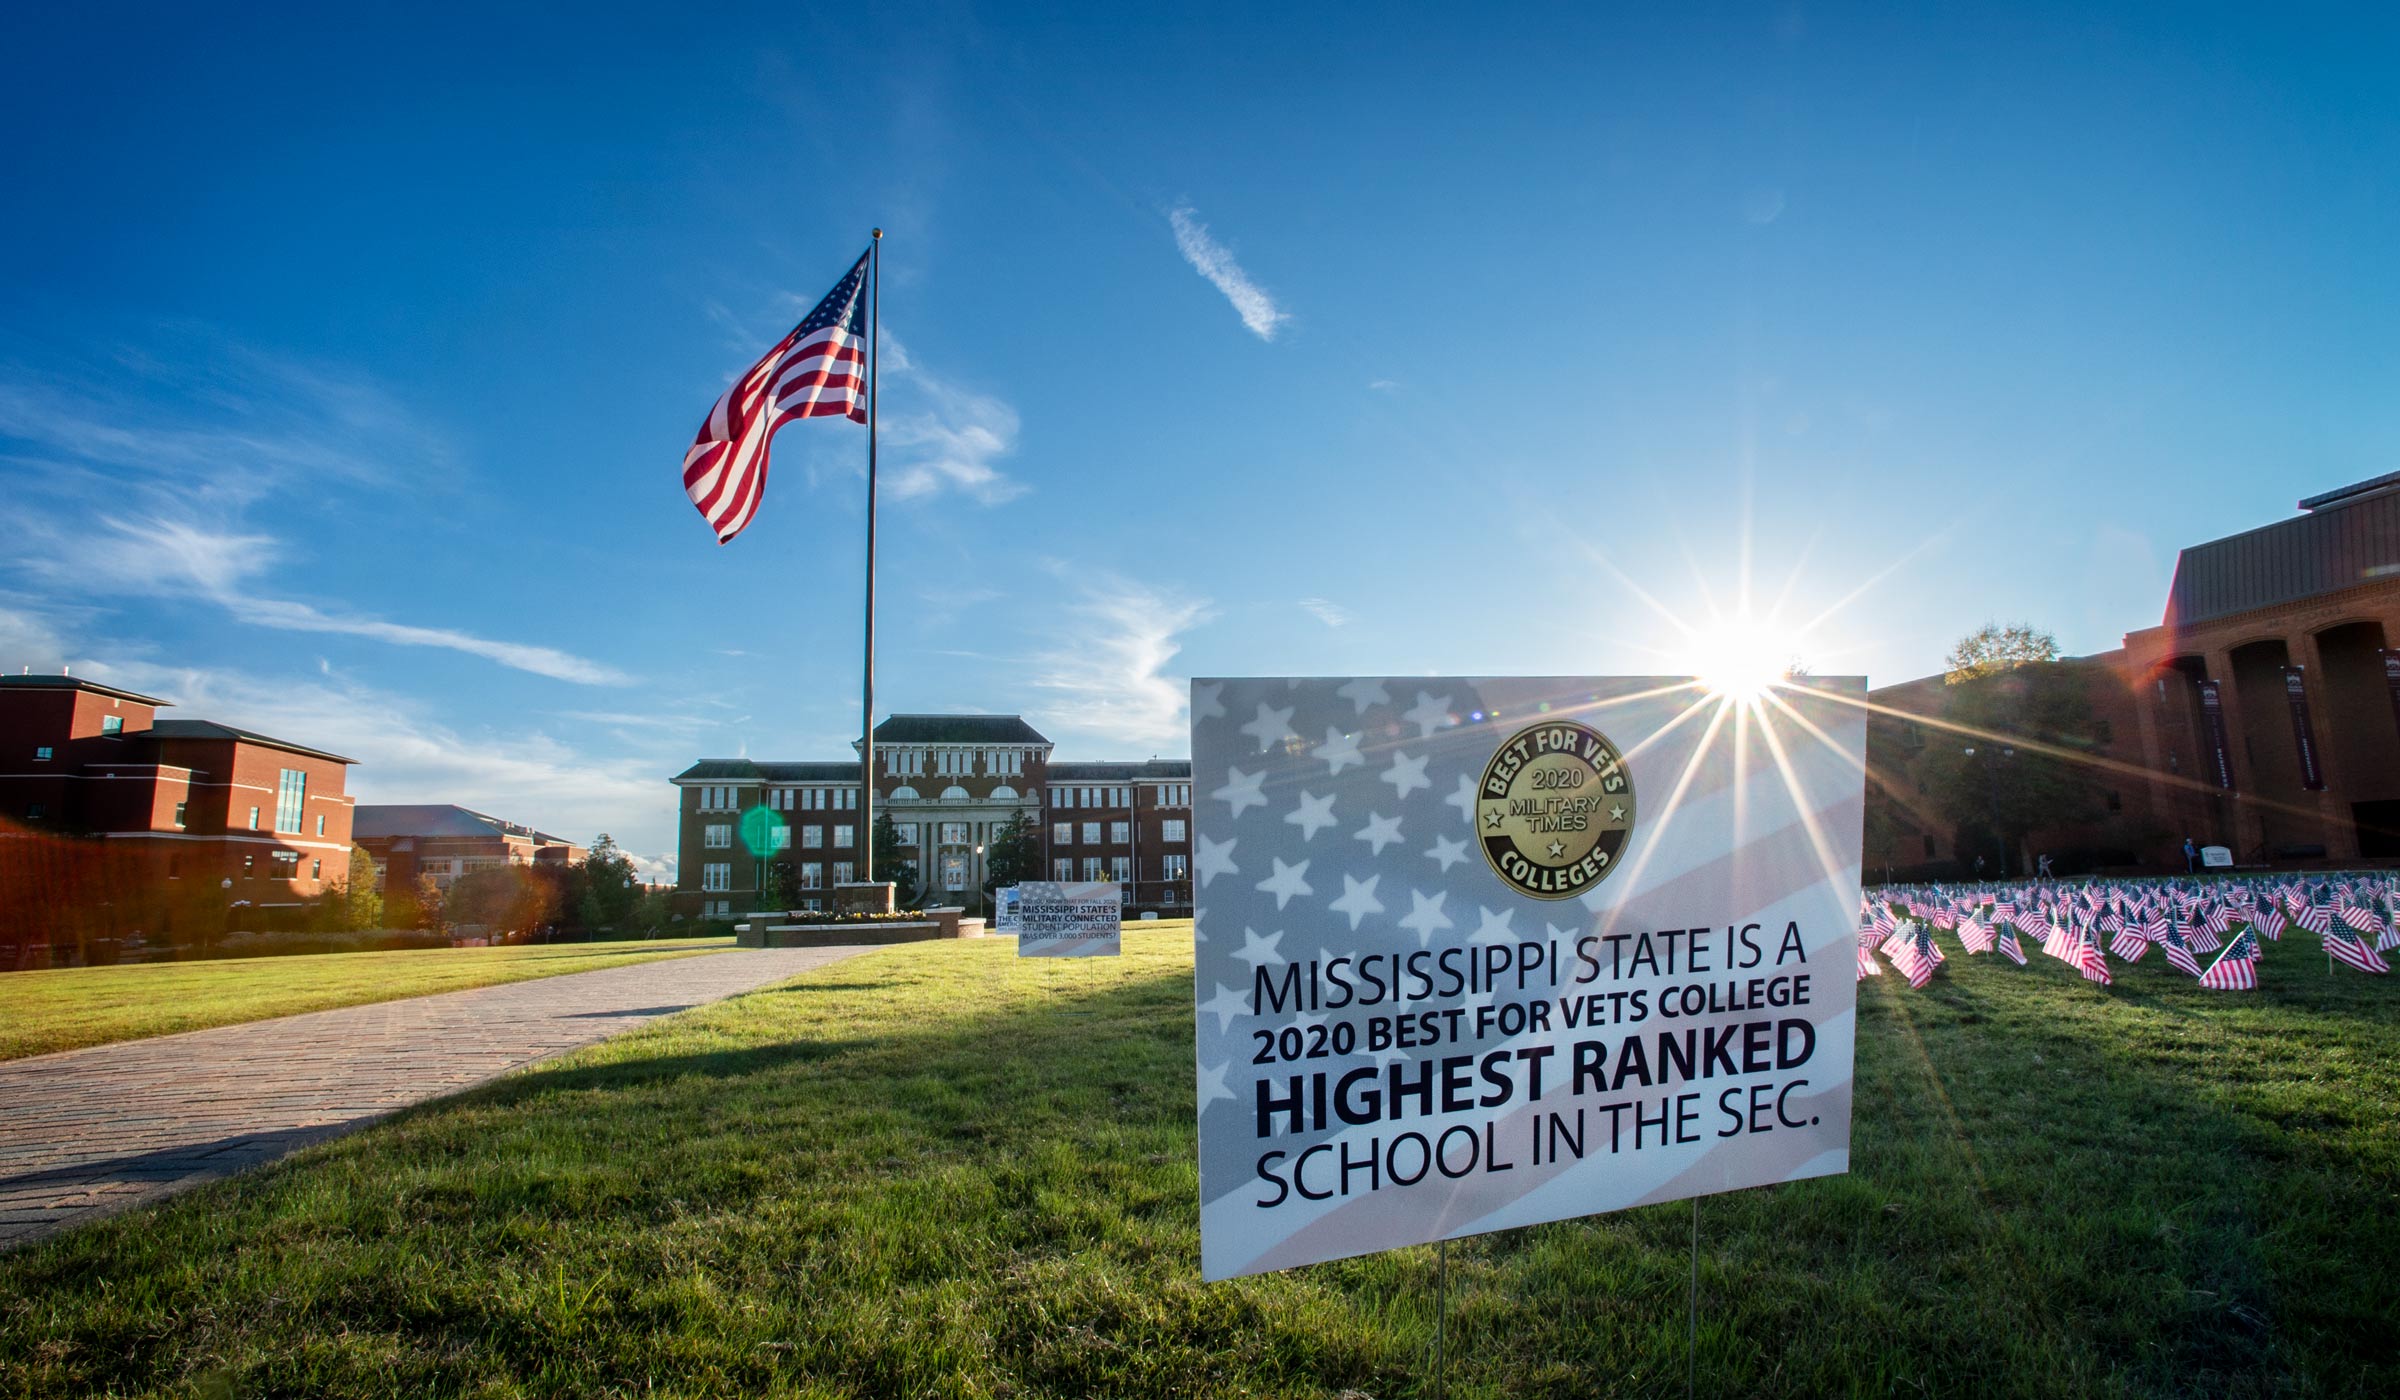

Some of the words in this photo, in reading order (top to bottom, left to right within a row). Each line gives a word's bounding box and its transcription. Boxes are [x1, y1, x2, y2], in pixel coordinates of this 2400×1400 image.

[1487, 740, 1531, 796] BEST
[1535, 729, 1579, 752] FOR
[1582, 737, 1625, 793] VETS
[1531, 768, 1584, 790] 2020
[1509, 796, 1602, 816] MILITARY
[1525, 815, 1588, 833] TIMES
[1500, 846, 1609, 891] COLLEGES
[1022, 905, 1078, 913] MISSISSIPPI
[1080, 905, 1117, 913] STATE'S
[1022, 923, 1061, 931] STUDENT
[1063, 923, 1117, 931] POPULATION
[1253, 941, 1557, 1017] MISSISSIPPI
[1575, 928, 1711, 984] STATE
[1727, 924, 1762, 970] IS
[1776, 921, 1807, 966] A
[1252, 1021, 1356, 1065] 2020
[1368, 1008, 1466, 1053] BEST
[1476, 999, 1551, 1040] FOR
[1559, 990, 1649, 1029] VETS
[1658, 974, 1811, 1019] COLLEGE
[1256, 1046, 1555, 1139] HIGHEST
[1572, 1018, 1816, 1096] RANKED
[1256, 1121, 1514, 1209] SCHOOL
[1533, 1108, 1585, 1166] IN
[1600, 1092, 1701, 1154] THE
[1717, 1079, 1820, 1138] SEC.
